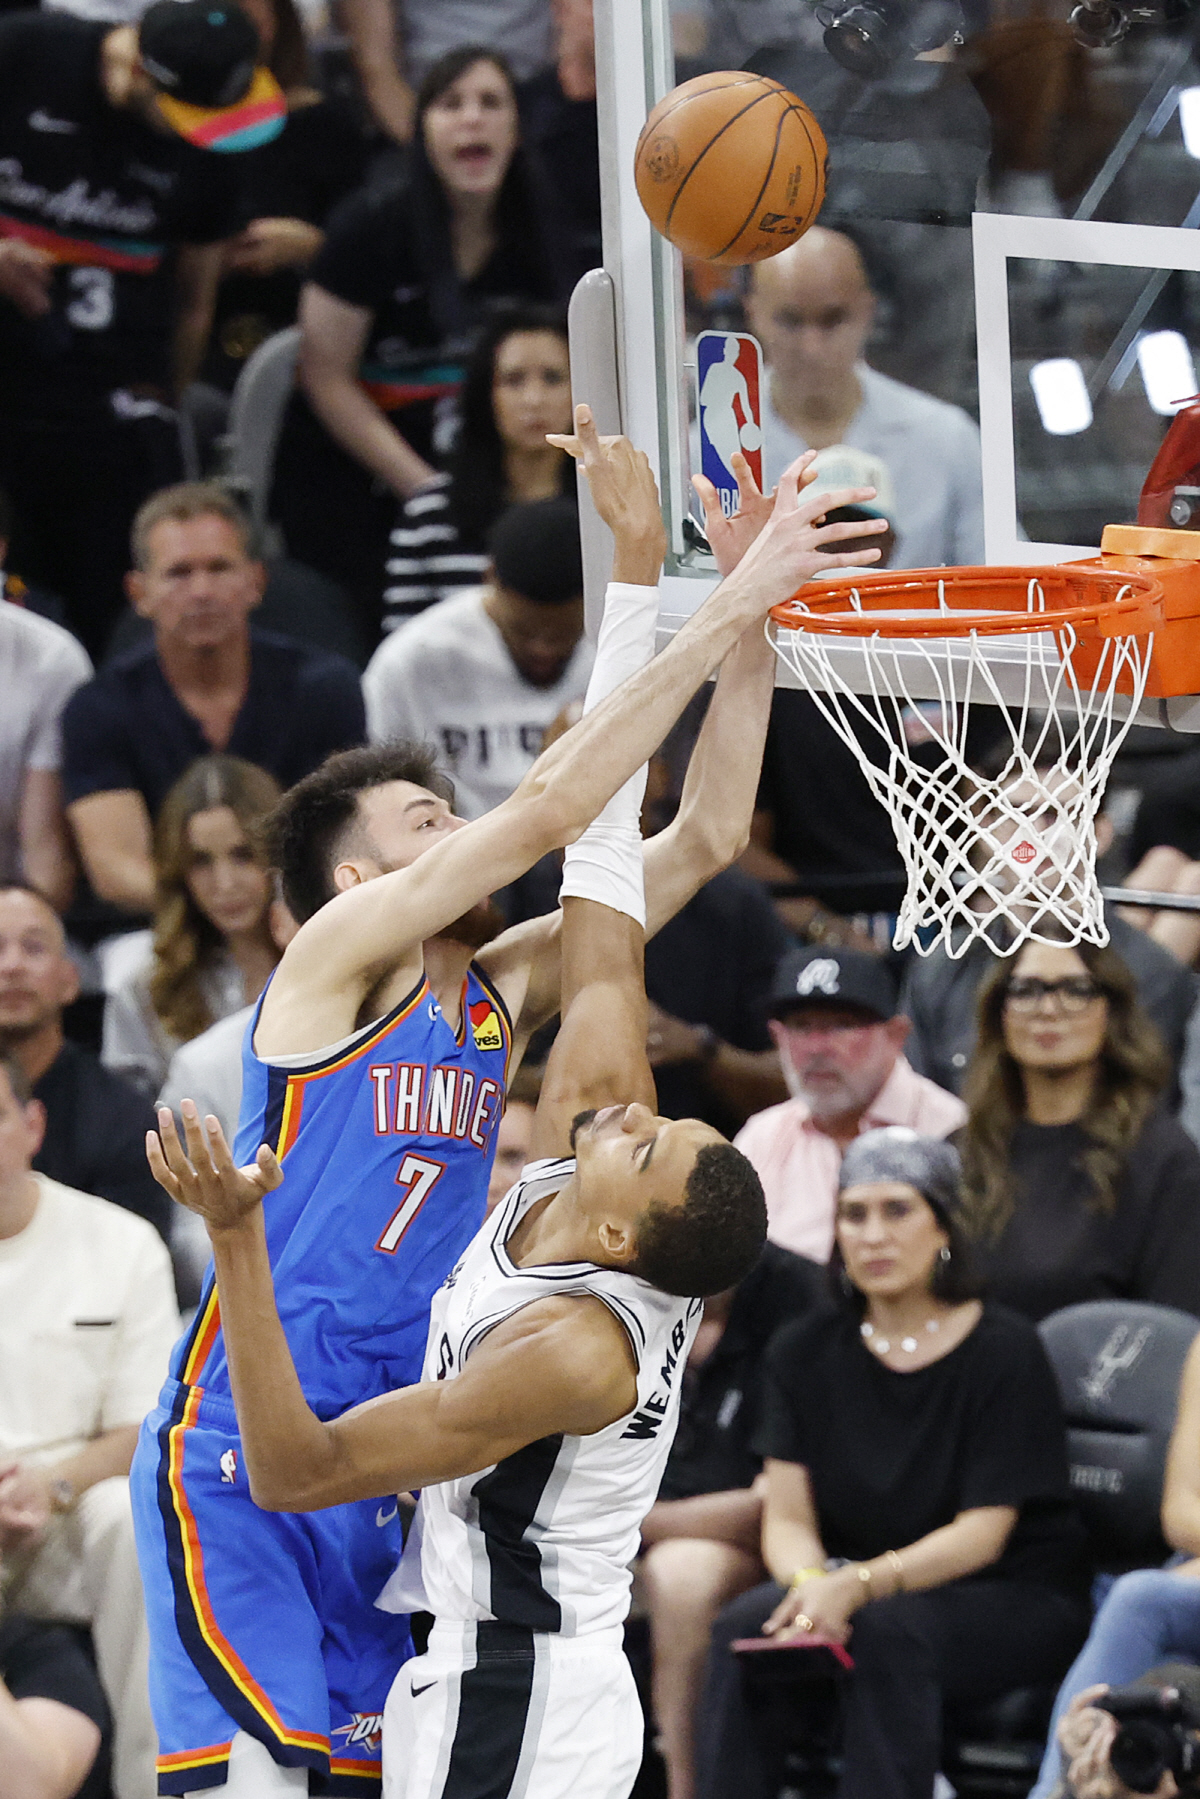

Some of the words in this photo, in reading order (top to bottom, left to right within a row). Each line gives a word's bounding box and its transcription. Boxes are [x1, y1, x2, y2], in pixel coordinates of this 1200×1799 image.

[67, 267, 115, 330] 3
[716, 487, 740, 519] BA
[474, 1034, 500, 1047] ves
[368, 1062, 503, 1159] THNDE
[373, 1151, 448, 1256] 7
